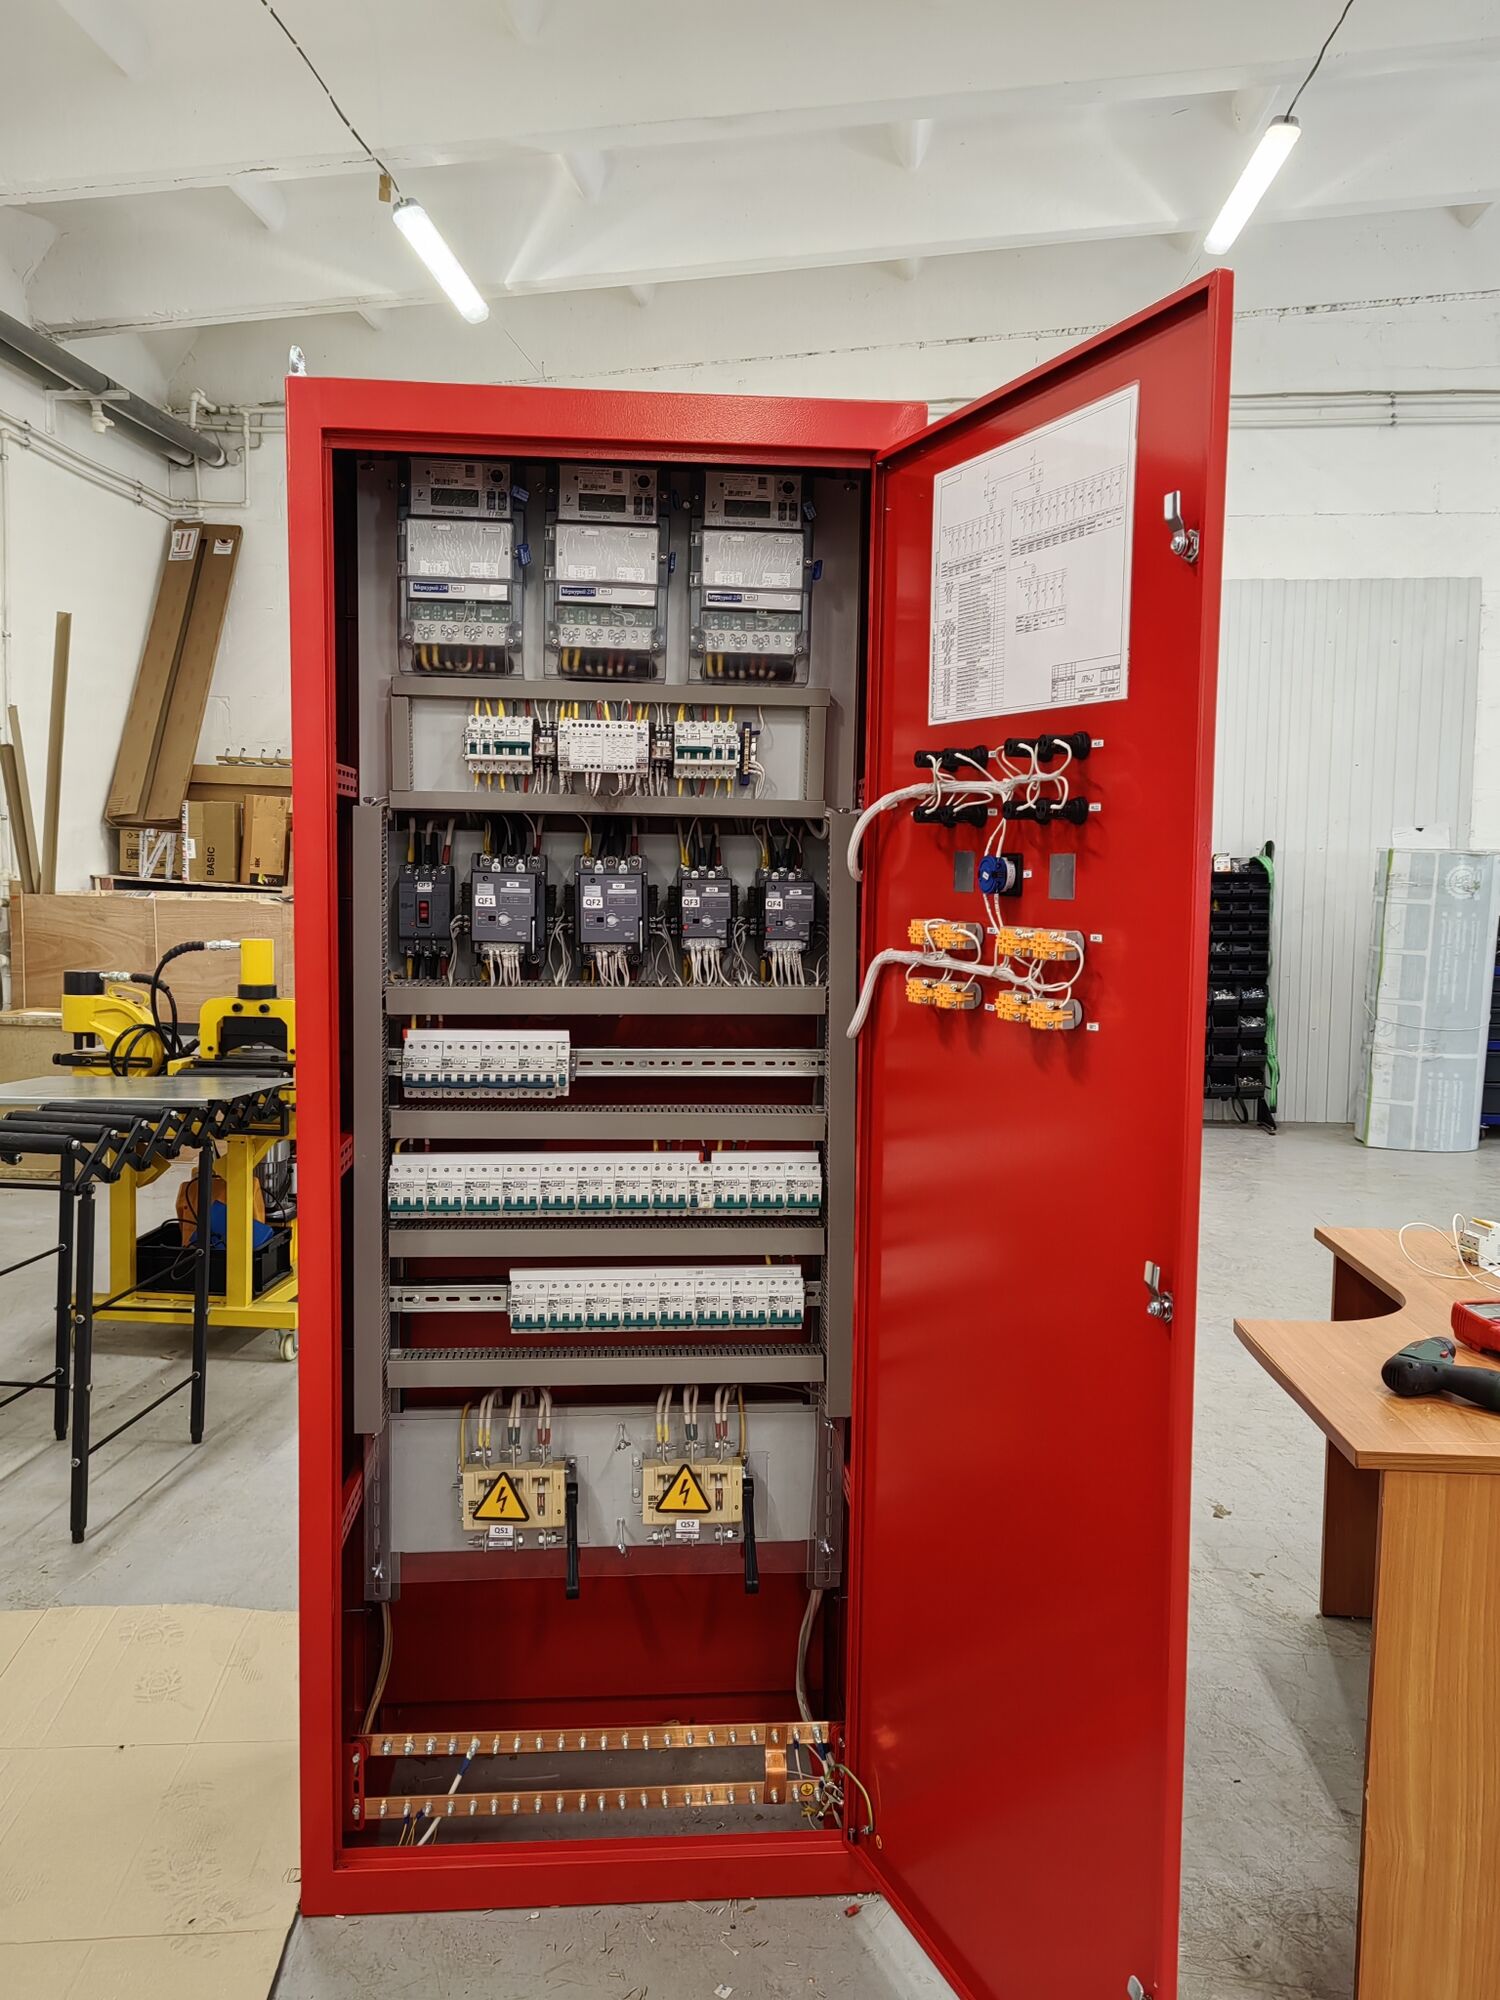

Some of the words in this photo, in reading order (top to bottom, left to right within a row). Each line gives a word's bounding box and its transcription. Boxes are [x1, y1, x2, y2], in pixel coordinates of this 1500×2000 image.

[413, 584, 438, 592] Меркурий
[206, 846, 215, 876] BASIC
[477, 896, 493, 906] QF1
[585, 898, 601, 907] QF2
[680, 1521, 695, 1529] QS2
[494, 1526, 508, 1535] QS1
